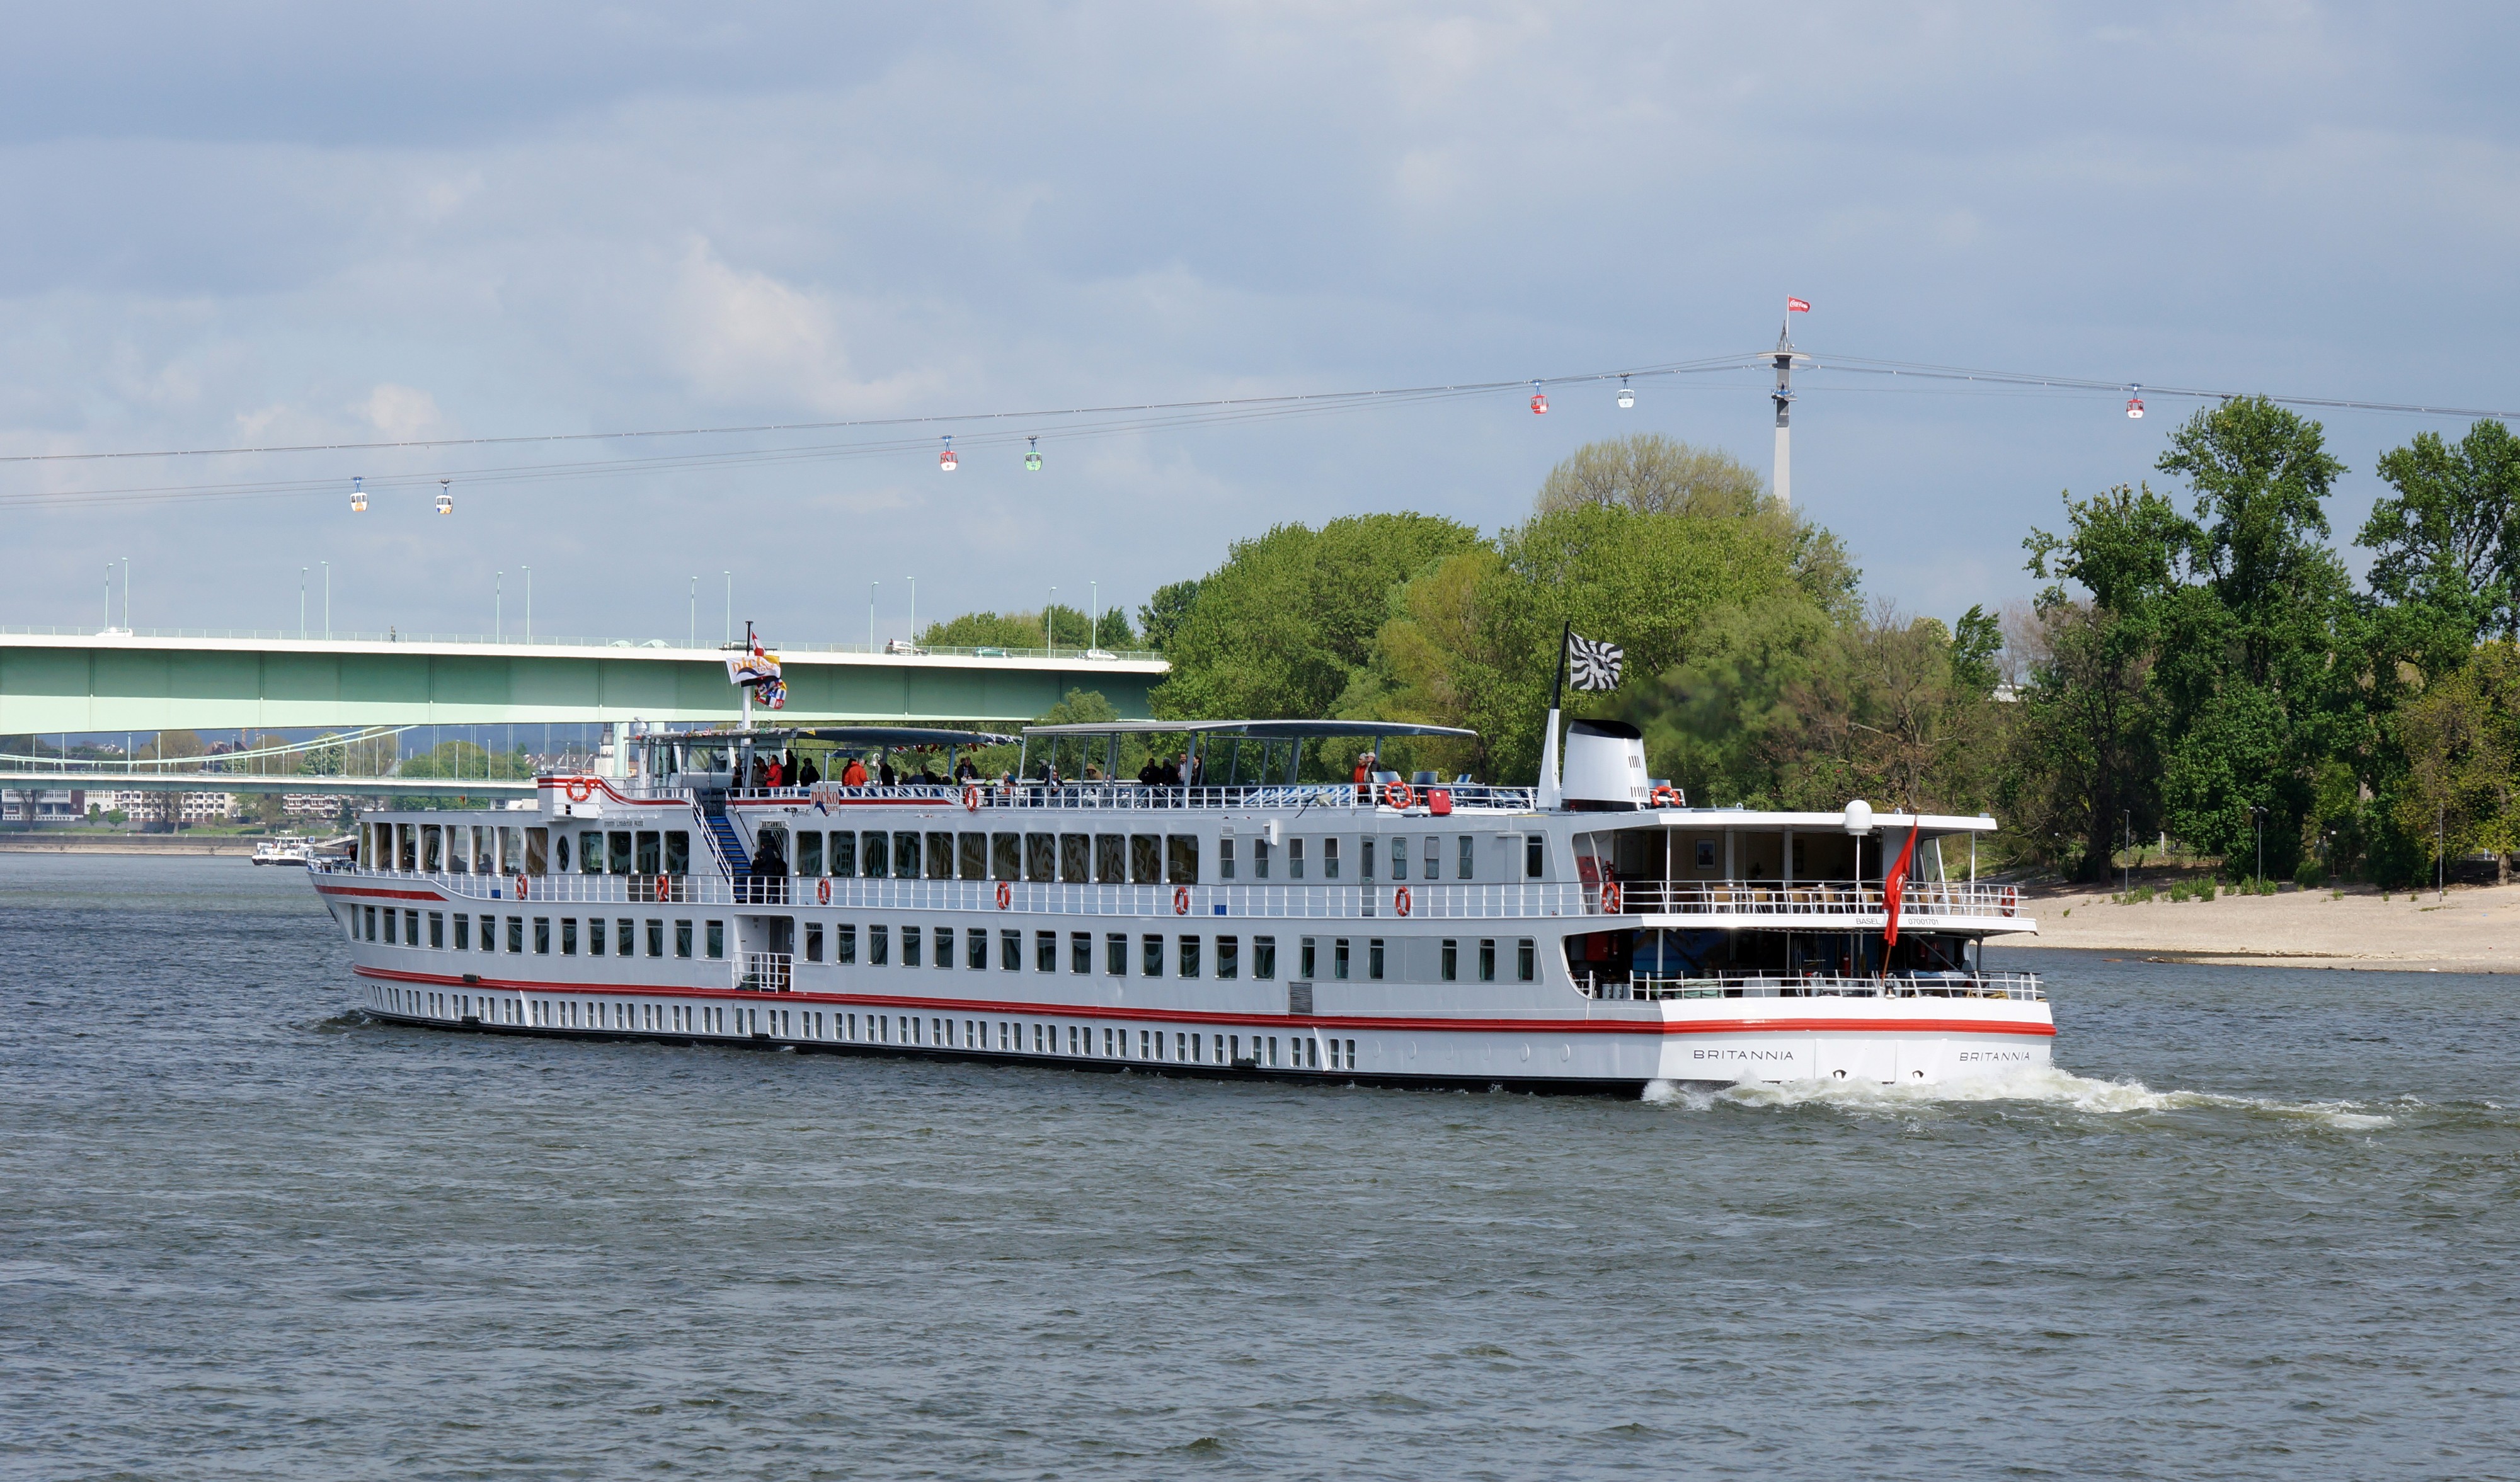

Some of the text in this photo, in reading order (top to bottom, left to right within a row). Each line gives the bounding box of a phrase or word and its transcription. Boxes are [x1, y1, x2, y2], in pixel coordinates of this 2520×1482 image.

[731, 657, 767, 673] nick
[811, 785, 838, 804] nicko
[1693, 1050, 1794, 1060] BRITANNIA
[1959, 1052, 2030, 1061] BRITANNIA
